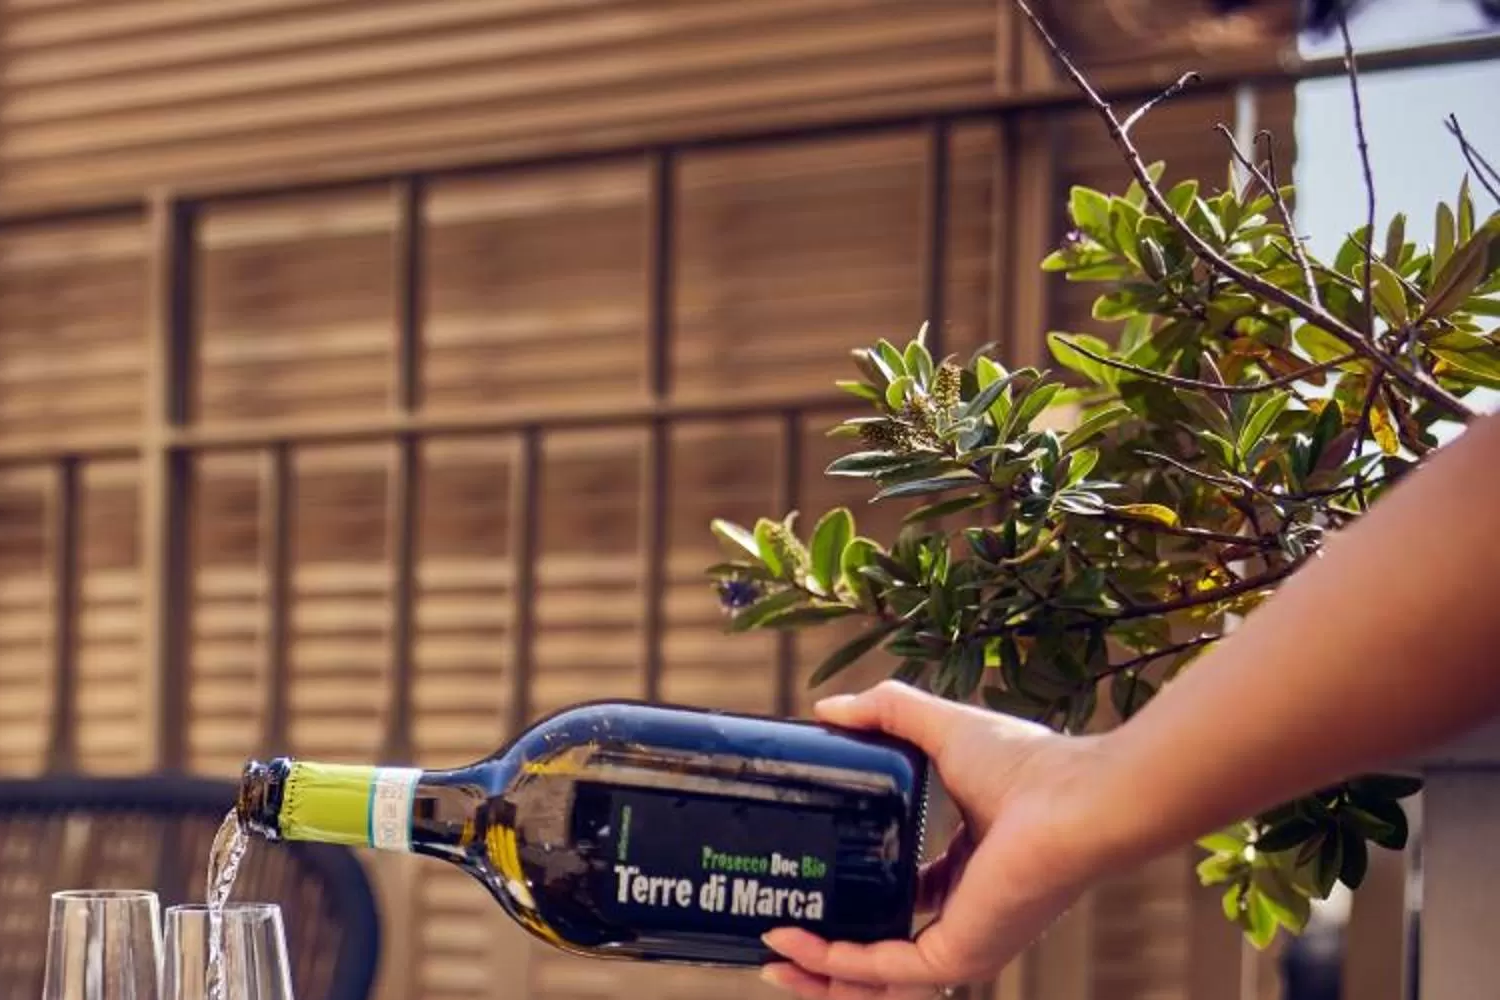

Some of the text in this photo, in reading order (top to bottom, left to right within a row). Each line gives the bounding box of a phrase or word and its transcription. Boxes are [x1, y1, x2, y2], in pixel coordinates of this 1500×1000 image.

[702, 845, 826, 878] Prosecco Doc Bio
[614, 865, 824, 920] Terre di Marca
